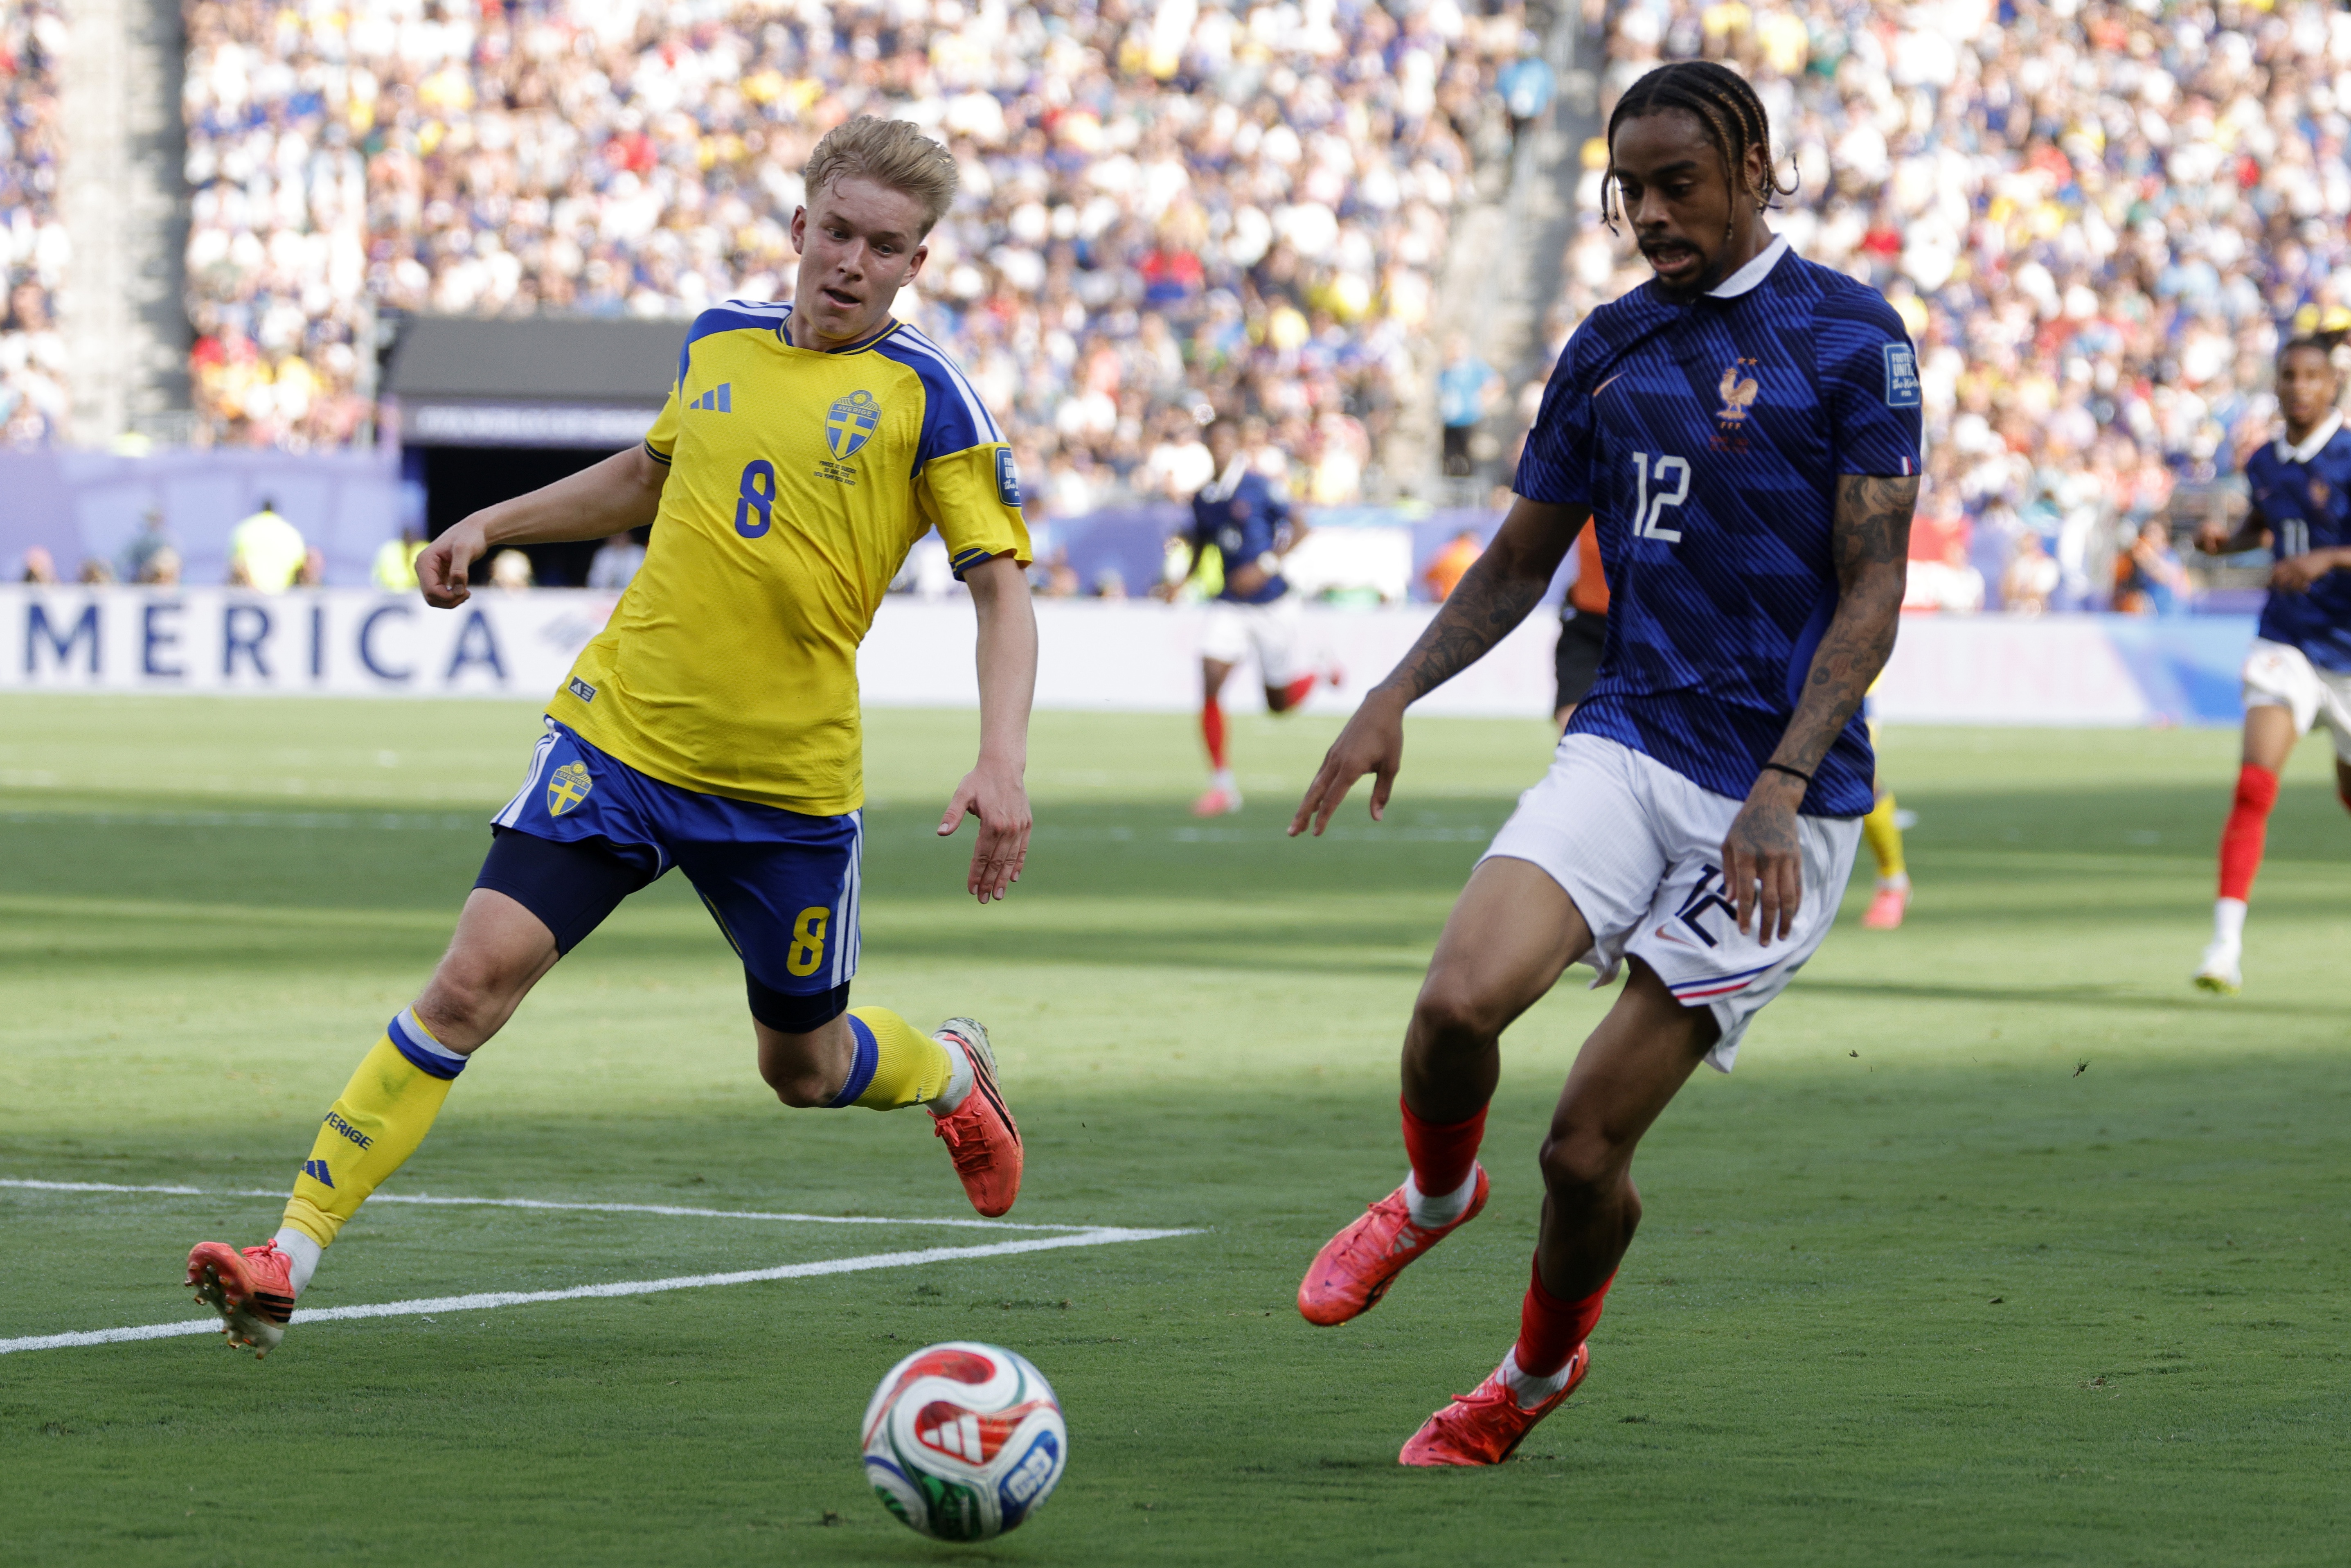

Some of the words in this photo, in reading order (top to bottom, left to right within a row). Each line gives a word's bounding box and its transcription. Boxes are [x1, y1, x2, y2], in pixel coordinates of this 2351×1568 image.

[837, 405, 873, 417] SVERIGE
[735, 459, 776, 538] 8
[1633, 451, 1691, 543] 12
[559, 772, 586, 787] SVERIGE
[786, 906, 831, 977] 8
